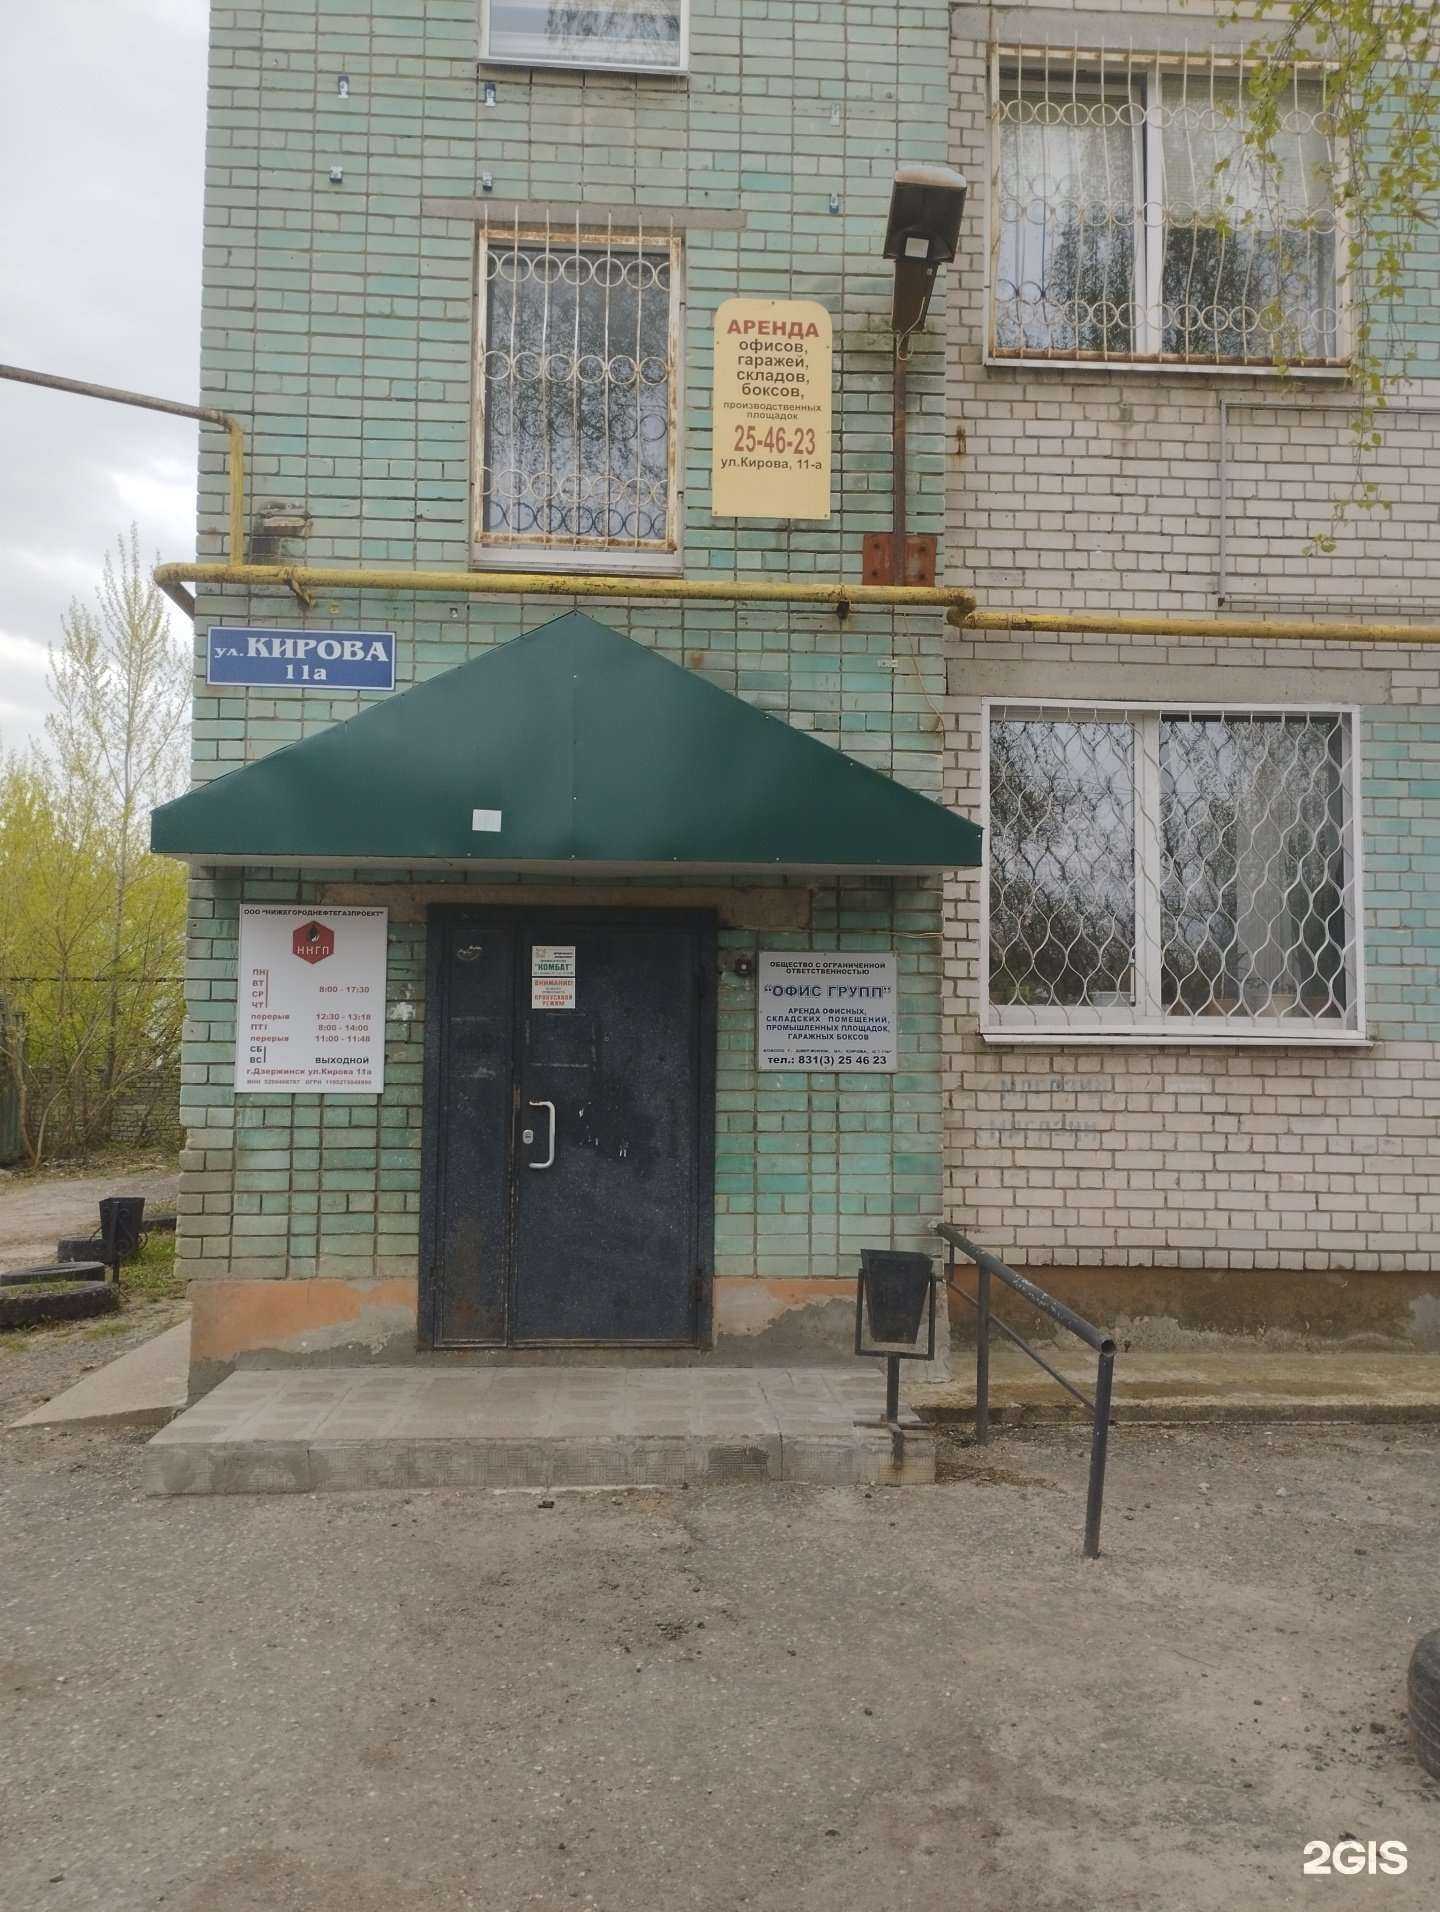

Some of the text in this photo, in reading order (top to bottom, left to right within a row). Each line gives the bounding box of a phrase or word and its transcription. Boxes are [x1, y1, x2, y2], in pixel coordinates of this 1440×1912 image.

[727, 319, 819, 339] АРЕНДА
[739, 339, 808, 355] офисов,
[737, 354, 809, 370] гаражей,
[736, 369, 810, 385] складов,
[741, 383, 804, 399] боксов,
[723, 401, 822, 412] производственных
[746, 411, 798, 421] площадок
[733, 424, 816, 455] 25-46-23
[720, 456, 823, 471] ул.Кирова, 11-а
[285, 665, 328, 681] 11а
[297, 945, 329, 956] ННГП
[252, 968, 265, 976] ПН
[252, 990, 264, 998] СР
[766, 1015, 890, 1024] СКЛАДСКИХ ПОМЕЩЕНИЙ,
[250, 1023, 263, 1031] ПТ
[345, 1024, 369, 1032] 14:00
[766, 1024, 890, 1033] ПРОМЫШЛЕННЫХ ПЛОЩАДОК,
[836, 1033, 869, 1041] БОКСОВ
[249, 1045, 263, 1053] СБ
[249, 1056, 370, 1065] ВС ВЫХОДНОЙ
[767, 1056, 887, 1066] тел.: 831(3) 25 46 23
